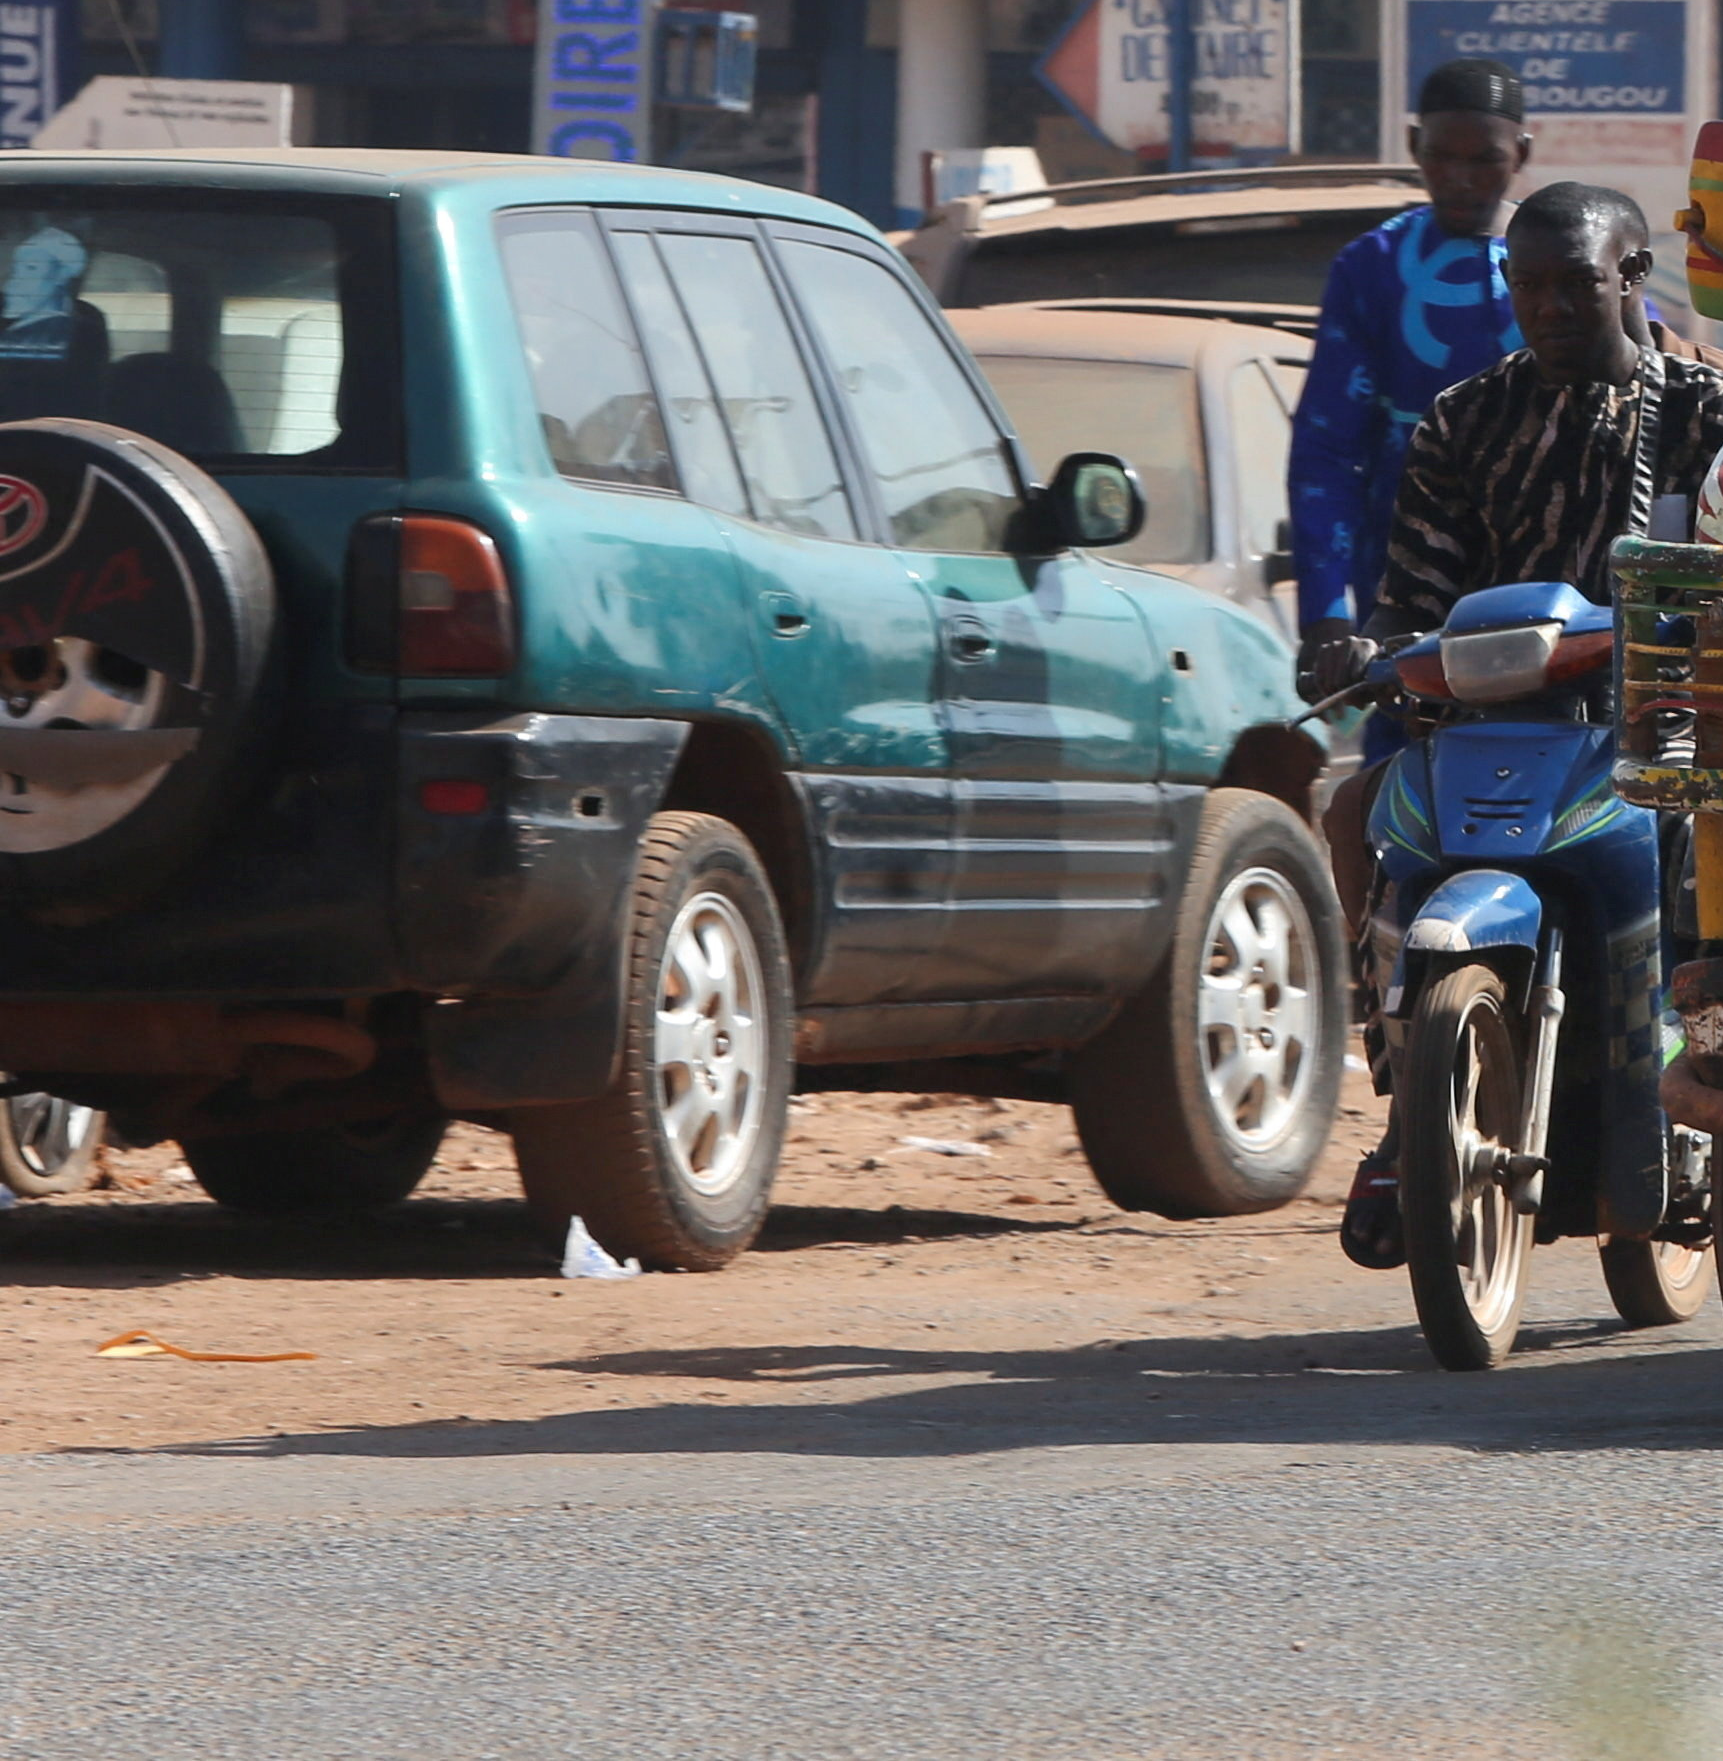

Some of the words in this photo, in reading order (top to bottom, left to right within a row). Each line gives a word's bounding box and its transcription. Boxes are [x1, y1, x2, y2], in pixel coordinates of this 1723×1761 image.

[1489, 1, 1612, 25] AGENCE
[1520, 58, 1571, 80] DE
[1523, 86, 1672, 107] BOUGOU
